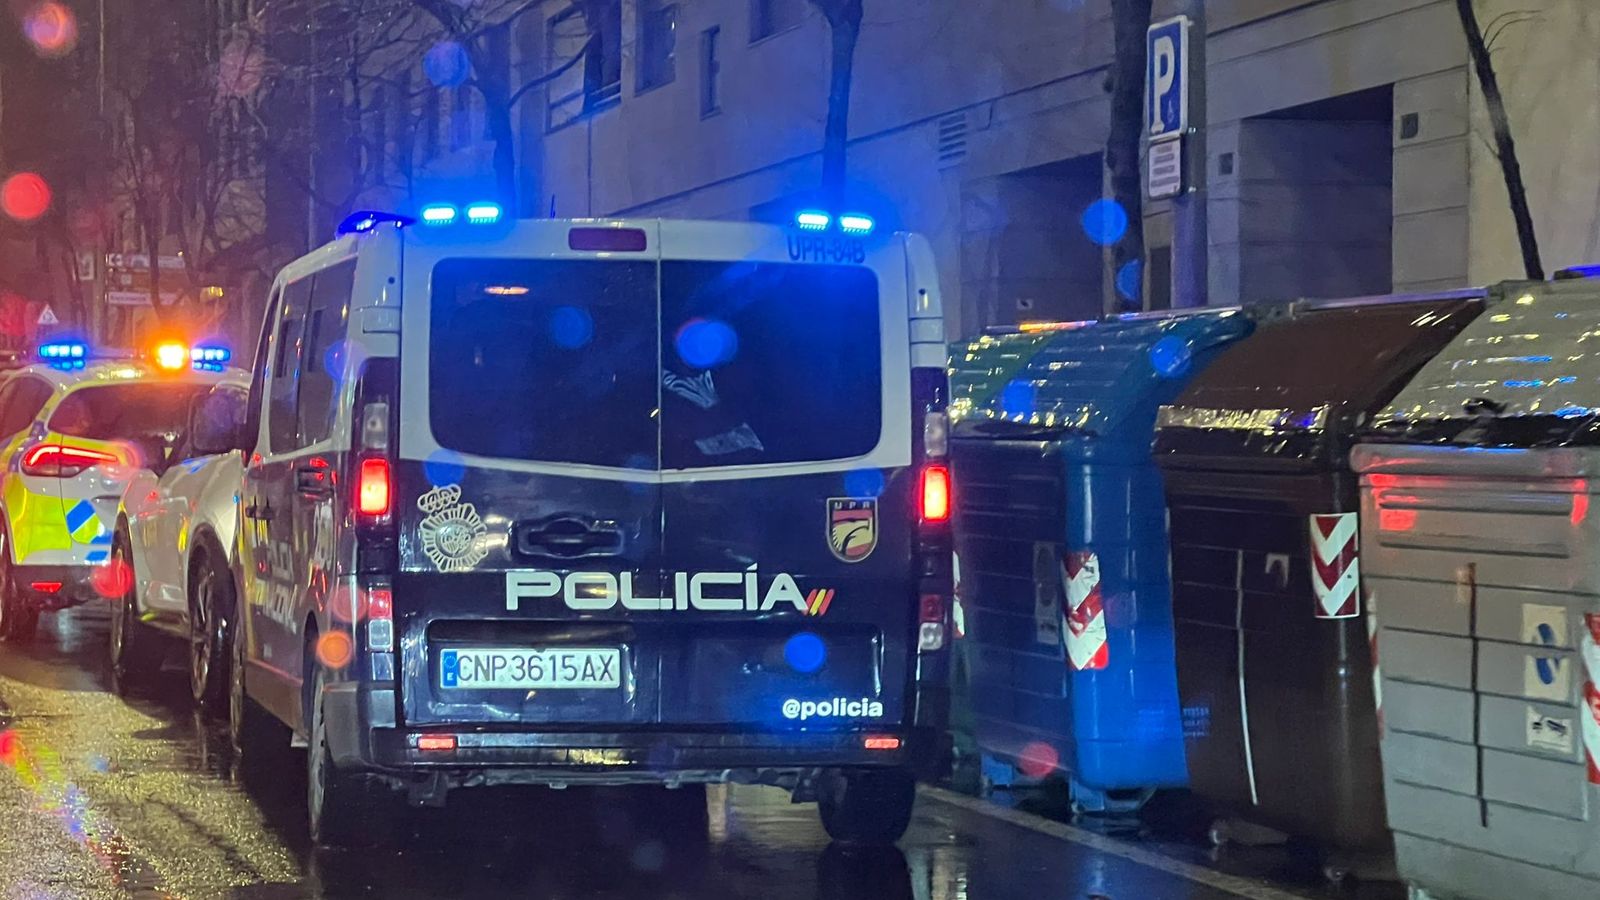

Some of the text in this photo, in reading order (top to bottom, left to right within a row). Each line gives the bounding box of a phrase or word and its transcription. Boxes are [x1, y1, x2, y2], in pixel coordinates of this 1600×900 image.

[1151, 36, 1175, 134] P
[506, 563, 808, 610] POLICÍA
[782, 697, 884, 720] @policia
